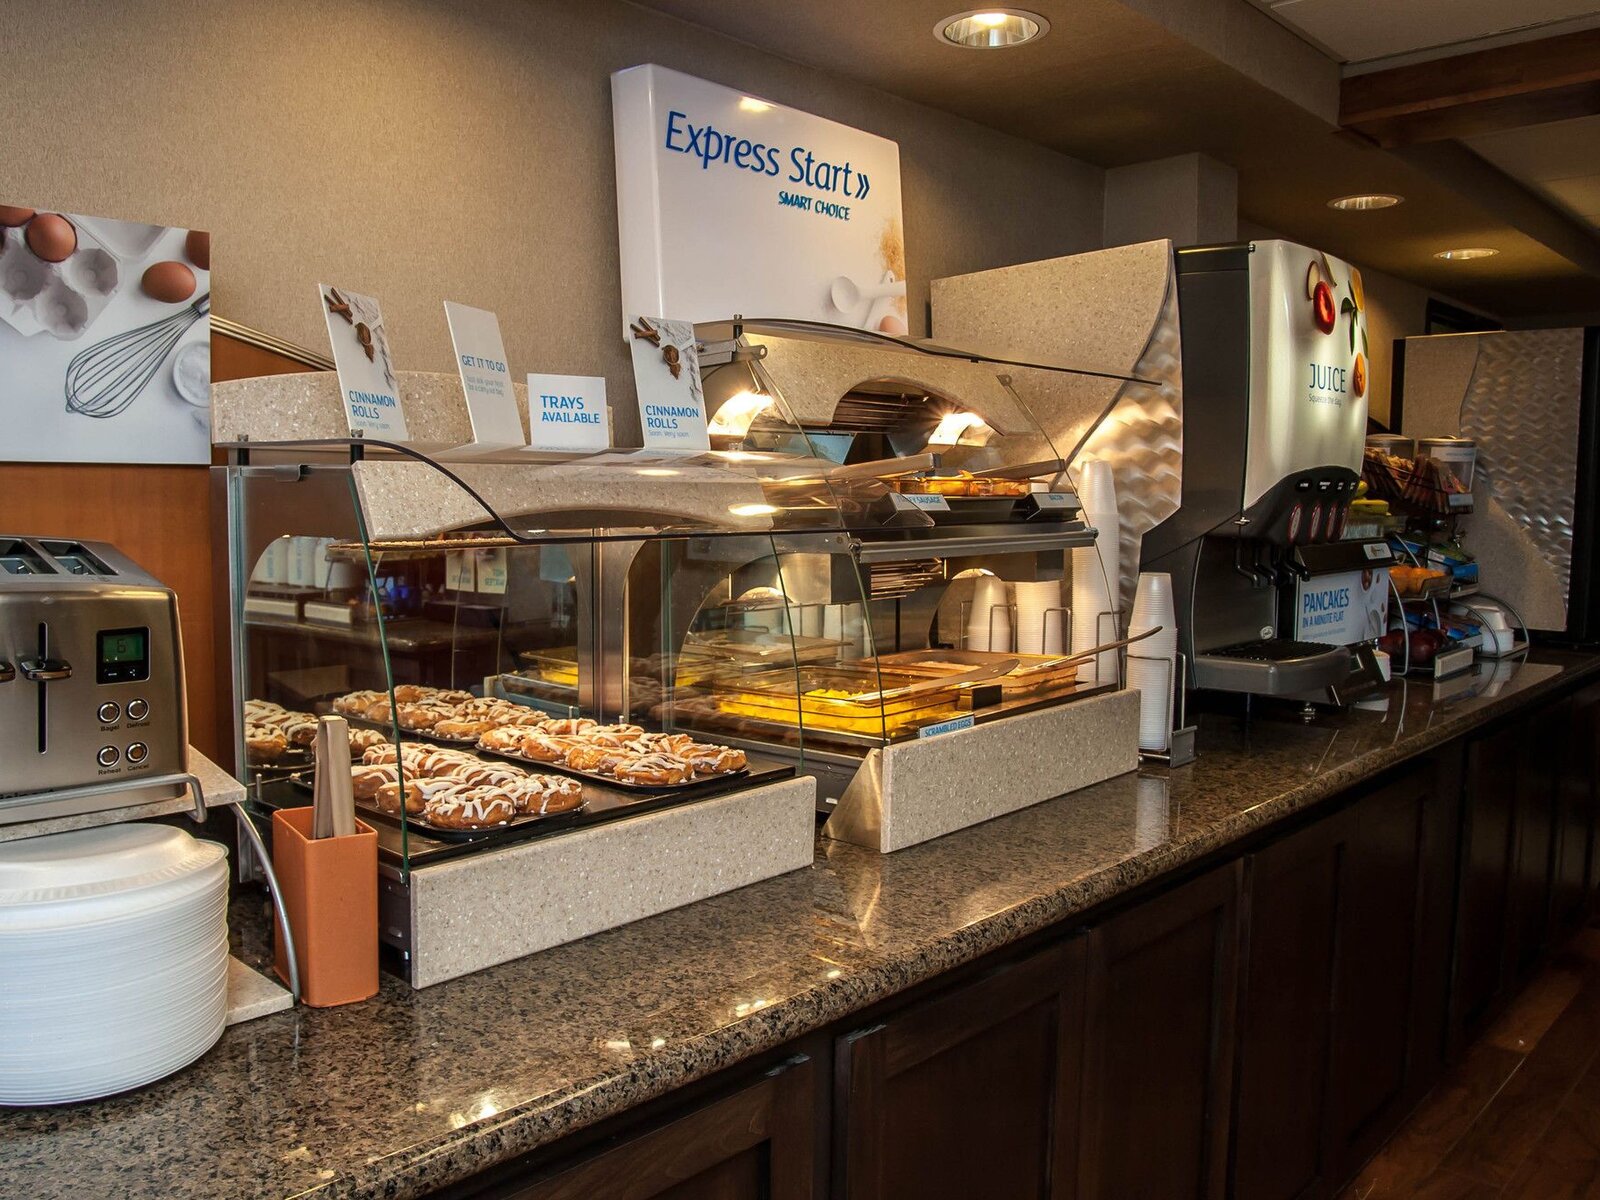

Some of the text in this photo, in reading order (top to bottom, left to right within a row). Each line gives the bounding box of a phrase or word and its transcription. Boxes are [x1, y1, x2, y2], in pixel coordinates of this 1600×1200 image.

[665, 110, 780, 176] Express
[778, 190, 851, 221] SMART CHOICE
[461, 354, 506, 373] GET IT TO GO
[1309, 363, 1346, 393] JUICE
[348, 390, 397, 408] CINNAMON
[540, 395, 584, 410] TRAYS
[351, 404, 380, 419] ROLLS
[541, 411, 601, 424] AVAILABLE
[645, 405, 700, 418] CINNAMON
[647, 417, 678, 429] ROLLS
[1303, 588, 1350, 614] PANCAKES
[1314, 612, 1333, 625] MINUTE
[1333, 610, 1345, 622] FLAT
[100, 724, 120, 732] Bagel
[126, 721, 150, 729] Defrost
[925, 718, 972, 737] SCRAMBLED EGGS
[98, 768, 121, 776] Reheat
